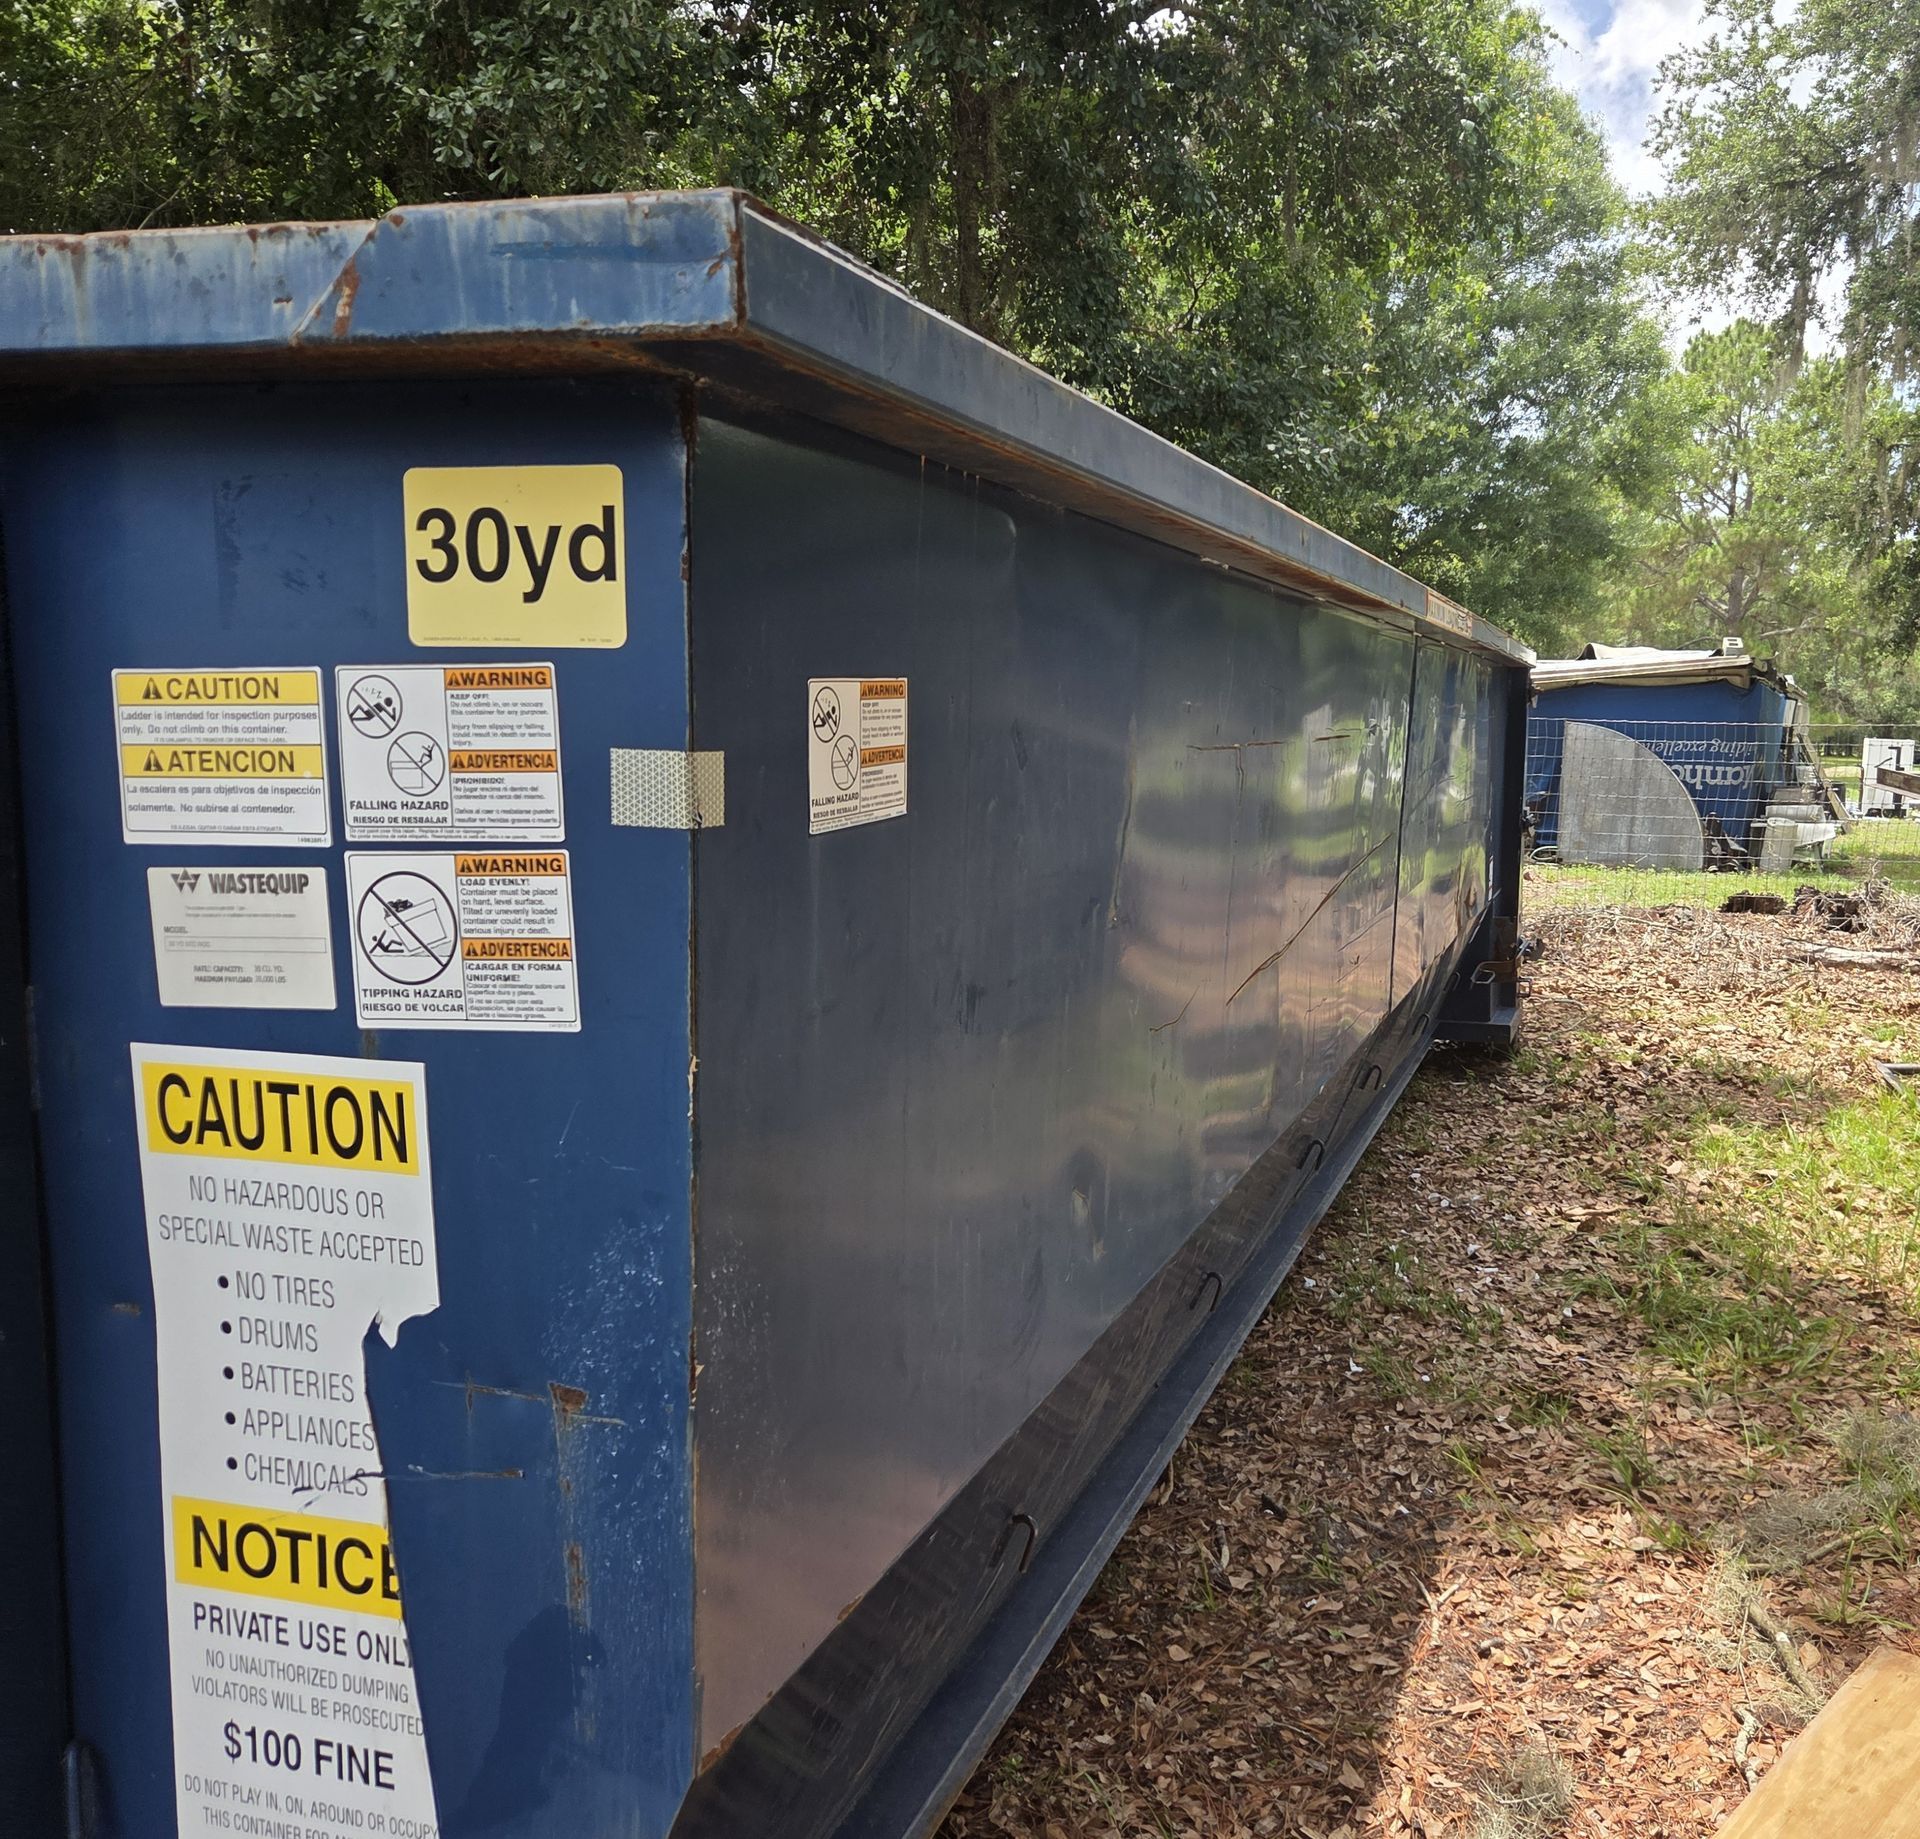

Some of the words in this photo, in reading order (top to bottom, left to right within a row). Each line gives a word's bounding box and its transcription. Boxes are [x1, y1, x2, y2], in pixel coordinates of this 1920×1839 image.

[415, 505, 617, 604] 30yd
[460, 671, 547, 686] WARNING
[166, 677, 279, 700] CAUTION
[866, 684, 904, 697] WARNING
[121, 711, 152, 720] Ladder
[154, 711, 162, 720] is
[164, 711, 204, 720] intended
[207, 711, 219, 720] for
[222, 711, 270, 722] inspection
[273, 712, 318, 722] purposes
[122, 724, 143, 736] only.
[148, 724, 160, 733] Do
[163, 724, 177, 733] not
[180, 724, 205, 733] climb
[208, 724, 219, 733] on
[222, 724, 239, 733] this
[242, 724, 287, 733] container.
[167, 750, 295, 773] ATENCION
[466, 753, 554, 769] ADVERTENCIA
[866, 747, 904, 763] ADVERTENCIA
[127, 784, 137, 793] La
[139, 784, 176, 793] escalera
[178, 784, 189, 793] es
[191, 786, 211, 796] para
[214, 784, 255, 797] objetivos
[257, 785, 270, 794] de
[350, 800, 397, 810] FALLING
[401, 800, 449, 810] HAZARD
[812, 796, 835, 808] FALLING
[836, 792, 859, 803] HAZARD
[180, 803, 193, 812] No
[194, 803, 229, 812] subirse
[241, 804, 295, 814] contenedor.
[353, 816, 384, 824] RIESGO
[387, 816, 400, 824] DE
[401, 816, 448, 824] RESBALAR
[472, 858, 563, 873] WARNING
[208, 873, 309, 896] WASTEQUIP
[460, 878, 486, 886] LOAD
[489, 878, 530, 886] EVENLY!
[532, 888, 558, 897] placed
[462, 907, 483, 915] Tilted
[485, 907, 493, 915] or
[494, 907, 529, 917] unevenly
[531, 907, 558, 915] loaded
[462, 917, 498, 925] container
[500, 917, 522, 925] could
[523, 917, 546, 925] result
[547, 917, 556, 925] in
[494, 926, 515, 936] injury
[480, 942, 569, 958] ADVERTENCIA
[511, 963, 525, 971] EN
[527, 963, 562, 971] FORMA
[361, 988, 410, 998] TIPPING
[413, 988, 463, 998] HAZARD
[362, 1003, 401, 1012] RIESGO
[404, 1003, 419, 1012] DE
[421, 1003, 464, 1012] VOLCAR
[158, 1073, 408, 1163] CAUTION
[189, 1175, 216, 1202] NO
[224, 1178, 348, 1215] HAZARDOUS
[355, 1191, 385, 1219] OR
[158, 1214, 239, 1247] SPECIAL
[242, 1223, 313, 1255] WASTE
[320, 1231, 424, 1266] ACCEPTED
[236, 1270, 265, 1299] NO
[271, 1275, 335, 1308] TIRES
[239, 1316, 318, 1352] DRUMS
[241, 1362, 354, 1402] BATTERIES
[243, 1408, 375, 1450] APPLIANCES
[245, 1453, 368, 1496] CHEMICALS
[193, 1601, 289, 1646] PRIVATE
[299, 1620, 347, 1656] USE
[205, 1648, 224, 1669] NO
[229, 1655, 338, 1690] UNAUTHORIZED
[343, 1674, 409, 1704] DUMPING
[192, 1675, 267, 1706] VIOLATORS
[272, 1692, 307, 1715] WILL
[311, 1699, 329, 1718] BE
[333, 1704, 424, 1737] PROSECUTED
[223, 1719, 301, 1771] $100
[313, 1738, 396, 1791] FINE
[184, 1774, 201, 1792] DO
[204, 1778, 229, 1799] NOT
[232, 1783, 263, 1806] PLAY
[266, 1791, 282, 1812] IN,
[285, 1796, 306, 1818] ON,
[310, 1801, 363, 1828] AROUND
[368, 1813, 385, 1832] OR
[389, 1817, 439, 1839] OCCUPY
[203, 1806, 231, 1828] THIS
[234, 1814, 301, 1839] CONTAINER
